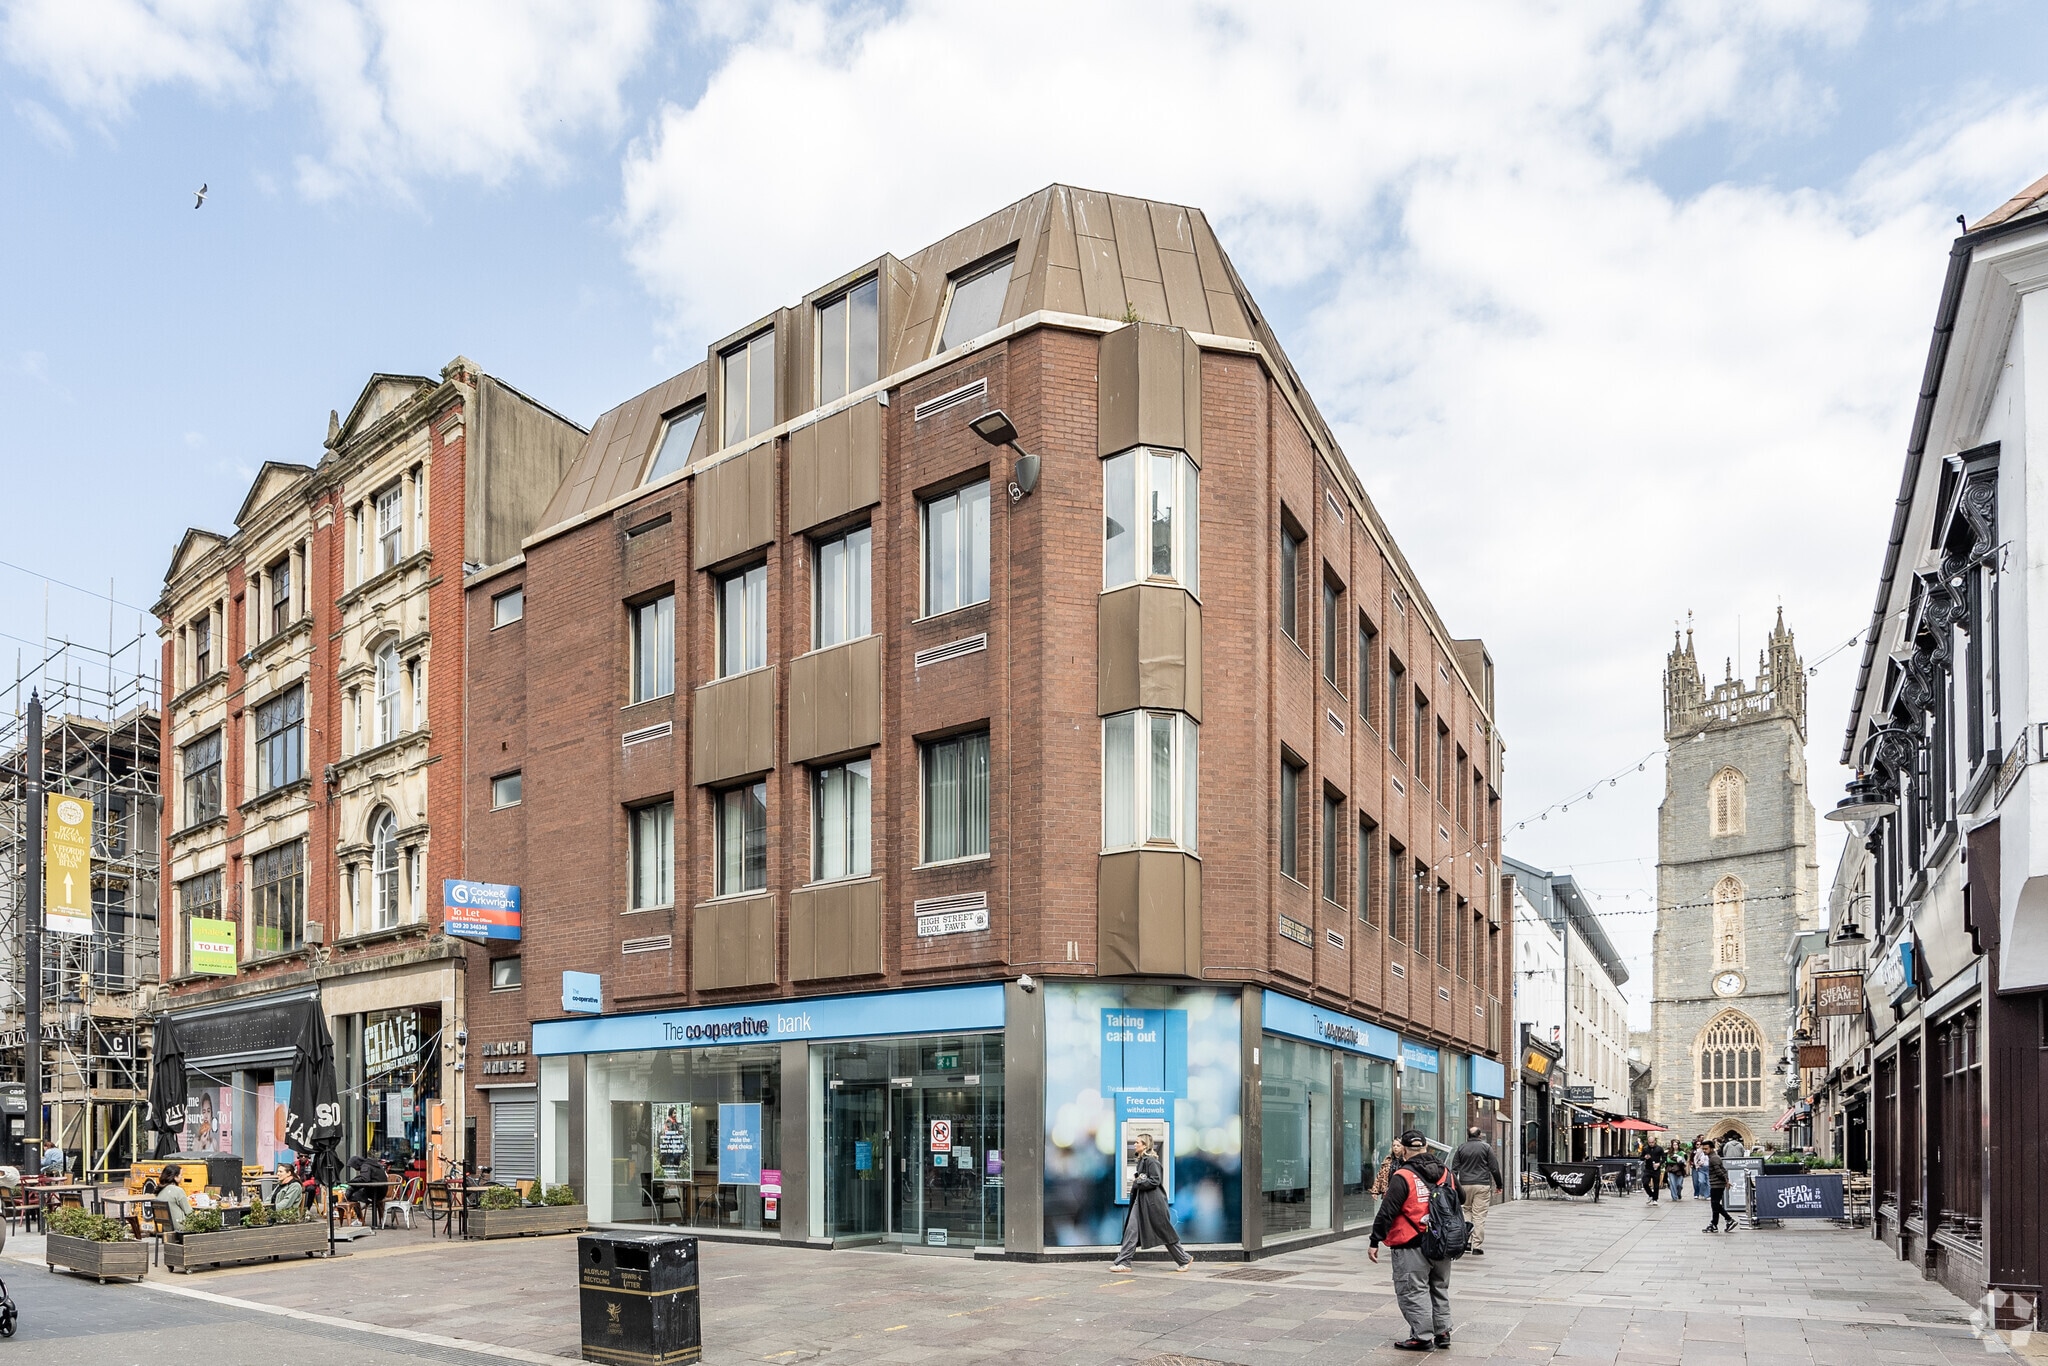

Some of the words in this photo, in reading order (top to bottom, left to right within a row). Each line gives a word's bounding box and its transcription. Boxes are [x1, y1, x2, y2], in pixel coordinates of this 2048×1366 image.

[53, 831, 70, 840] THIS
[70, 835, 86, 844] WAY
[60, 826, 80, 836] PIZZA
[52, 844, 58, 852] Y
[58, 845, 85, 856] FFORDD
[55, 850, 70, 862] YMA
[72, 854, 82, 863] AM
[470, 896, 515, 908] Arkwright
[466, 908, 480, 917] Let
[920, 917, 939, 926] HIGH
[942, 913, 974, 923] STREET
[920, 925, 941, 934] HEOL
[944, 922, 966, 931] FAWR
[1826, 986, 1847, 996] HEAD
[1819, 991, 1852, 1006] STEAM
[663, 1022, 684, 1040] The
[686, 1016, 769, 1042] co-operative
[777, 1011, 811, 1033] bank
[1106, 1015, 1144, 1029] Taking
[1106, 1030, 1133, 1042] cash
[1137, 1031, 1156, 1042] out
[1313, 1014, 1323, 1036] The
[1324, 1022, 1358, 1047] co-operative
[1358, 1028, 1369, 1047] bank
[113, 1037, 123, 1051] C
[364, 1015, 403, 1066] CHAI
[482, 1041, 527, 1056] OLIVER
[483, 1060, 526, 1074] HOUSE
[1126, 1096, 1144, 1104] Free
[1146, 1096, 1165, 1104] cash
[1550, 1171, 1585, 1184] Coca-Cola
[1784, 1185, 1807, 1196] HEAD
[1777, 1192, 1813, 1209] STEAM
[584, 1276, 610, 1285] RECYCLING
